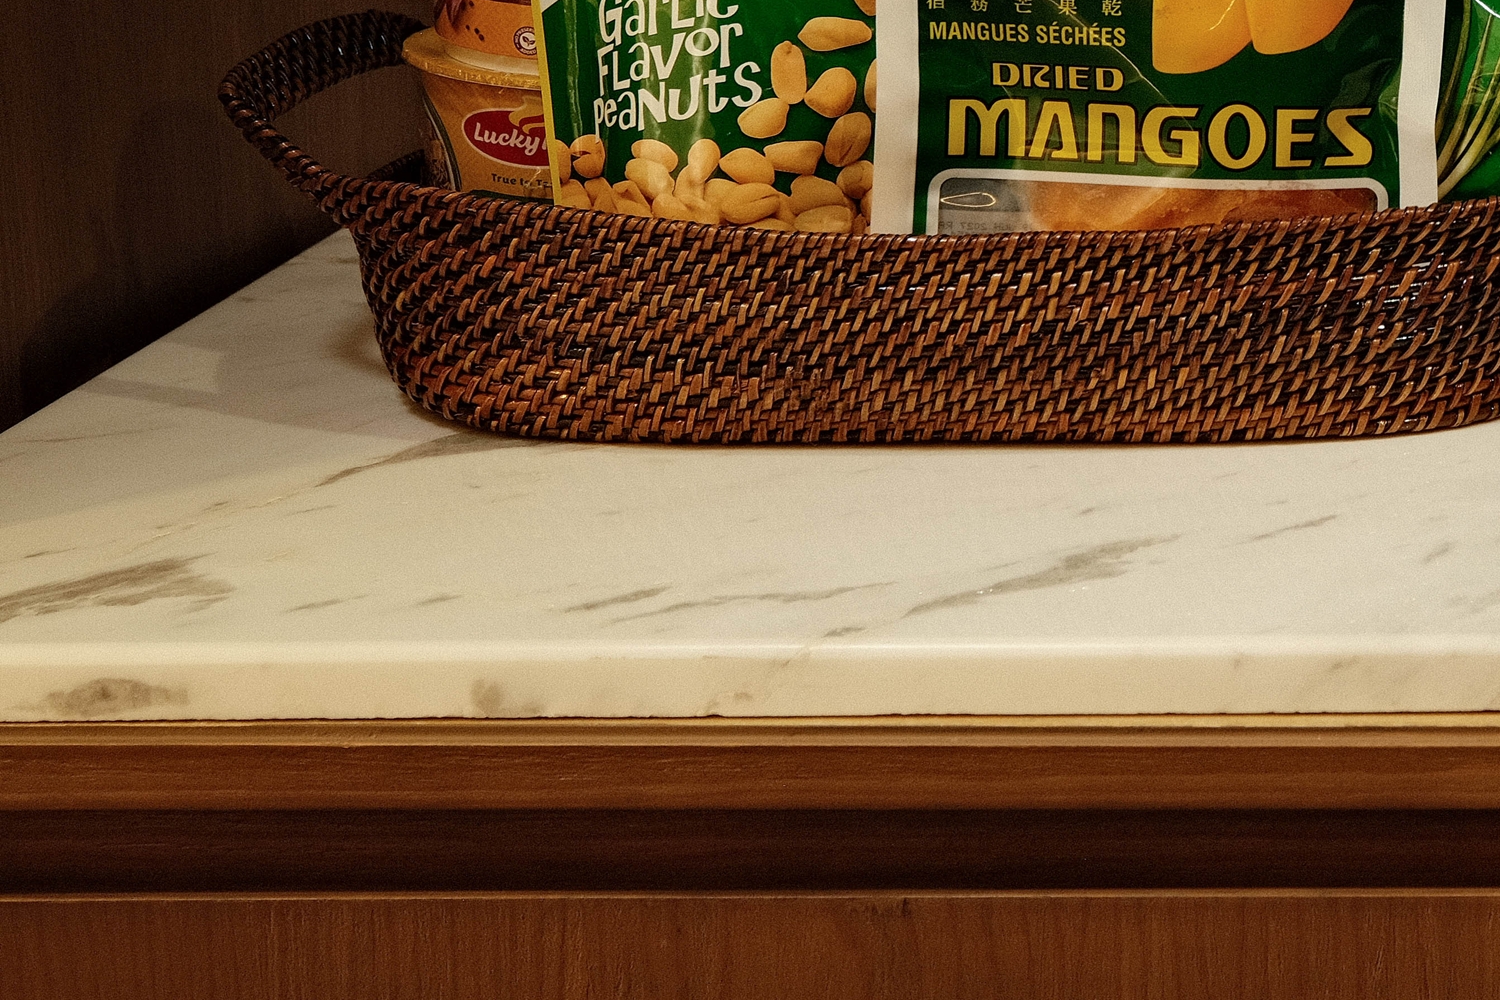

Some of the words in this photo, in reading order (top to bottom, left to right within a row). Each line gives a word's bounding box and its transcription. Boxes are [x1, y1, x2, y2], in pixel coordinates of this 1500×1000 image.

[929, 21, 1030, 44] MANGUES
[1036, 20, 1127, 47] SÉCHÉES
[991, 62, 1125, 92] DRIED
[473, 122, 540, 156] Lucky
[947, 97, 1374, 170] MANGOES
[491, 173, 517, 185] True
